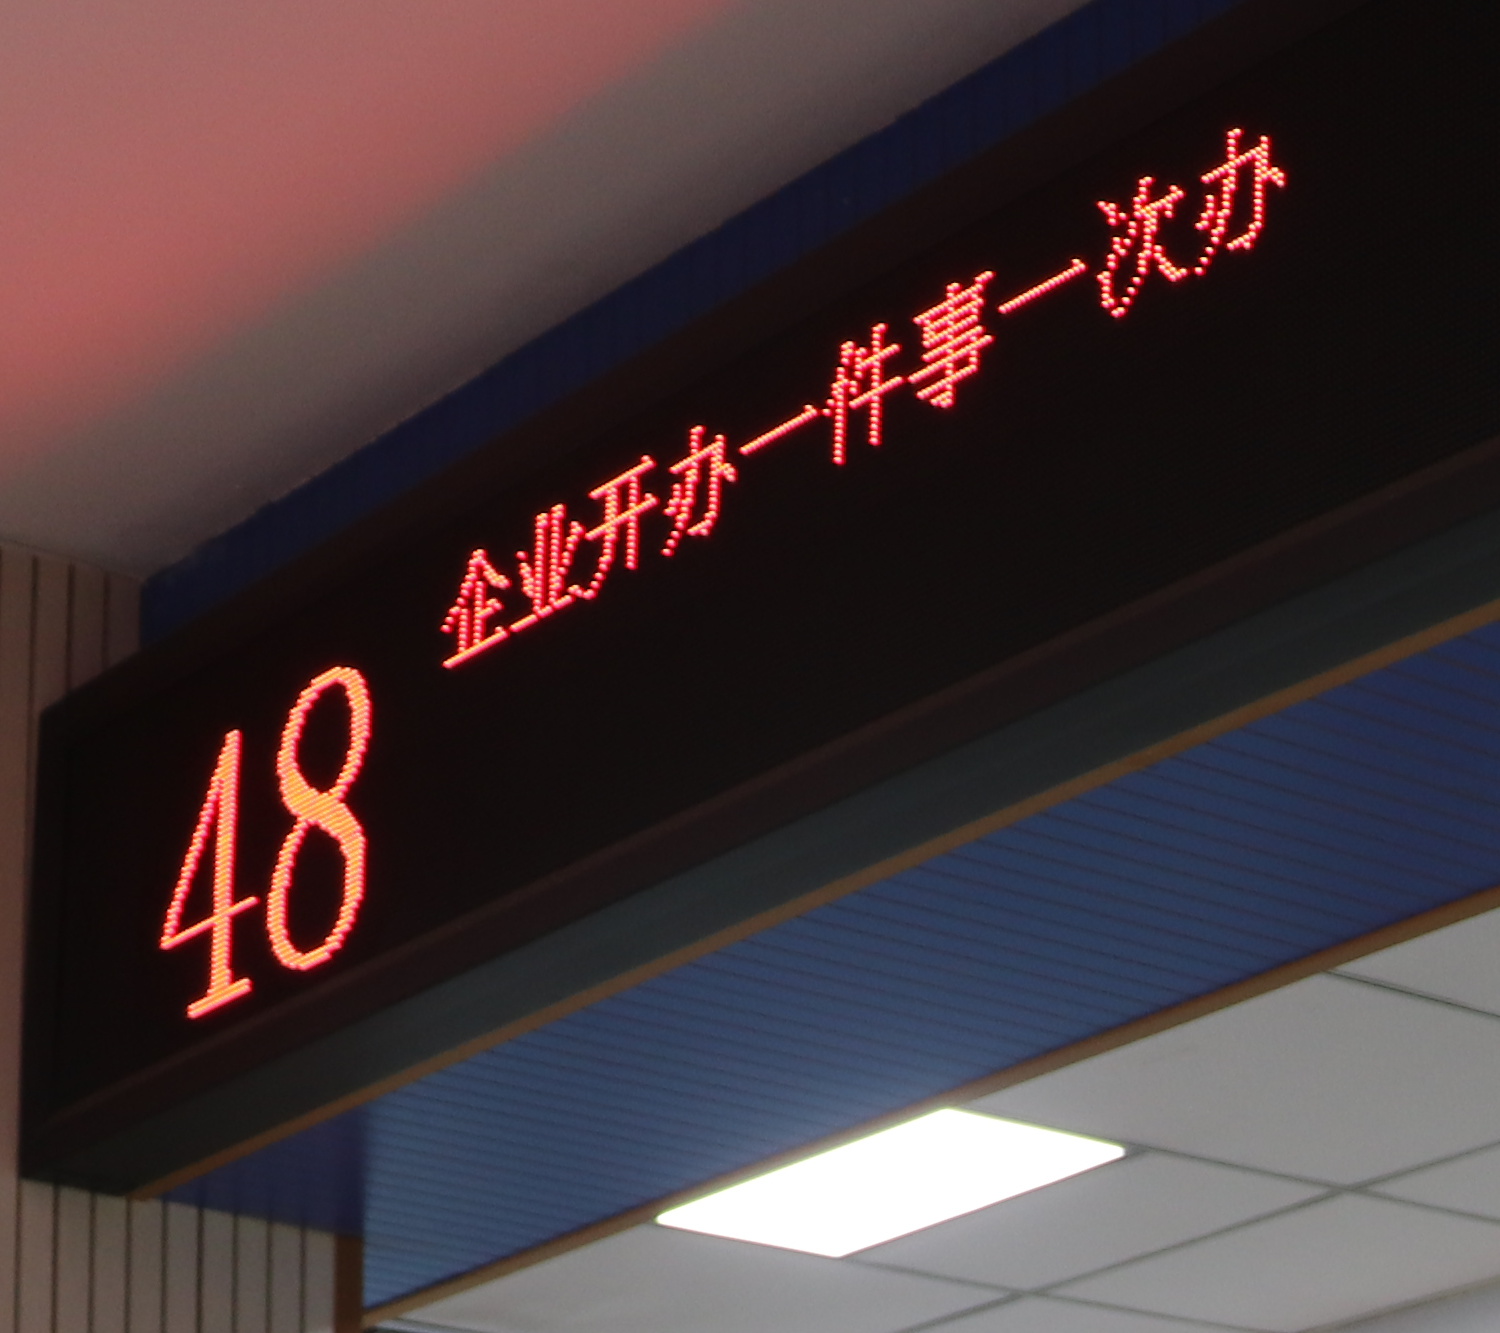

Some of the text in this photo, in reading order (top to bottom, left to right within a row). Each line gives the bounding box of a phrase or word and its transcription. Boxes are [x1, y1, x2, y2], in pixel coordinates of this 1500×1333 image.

[438, 127, 1288, 669] 企业开办一件事一次办
[157, 664, 374, 1020] 48
